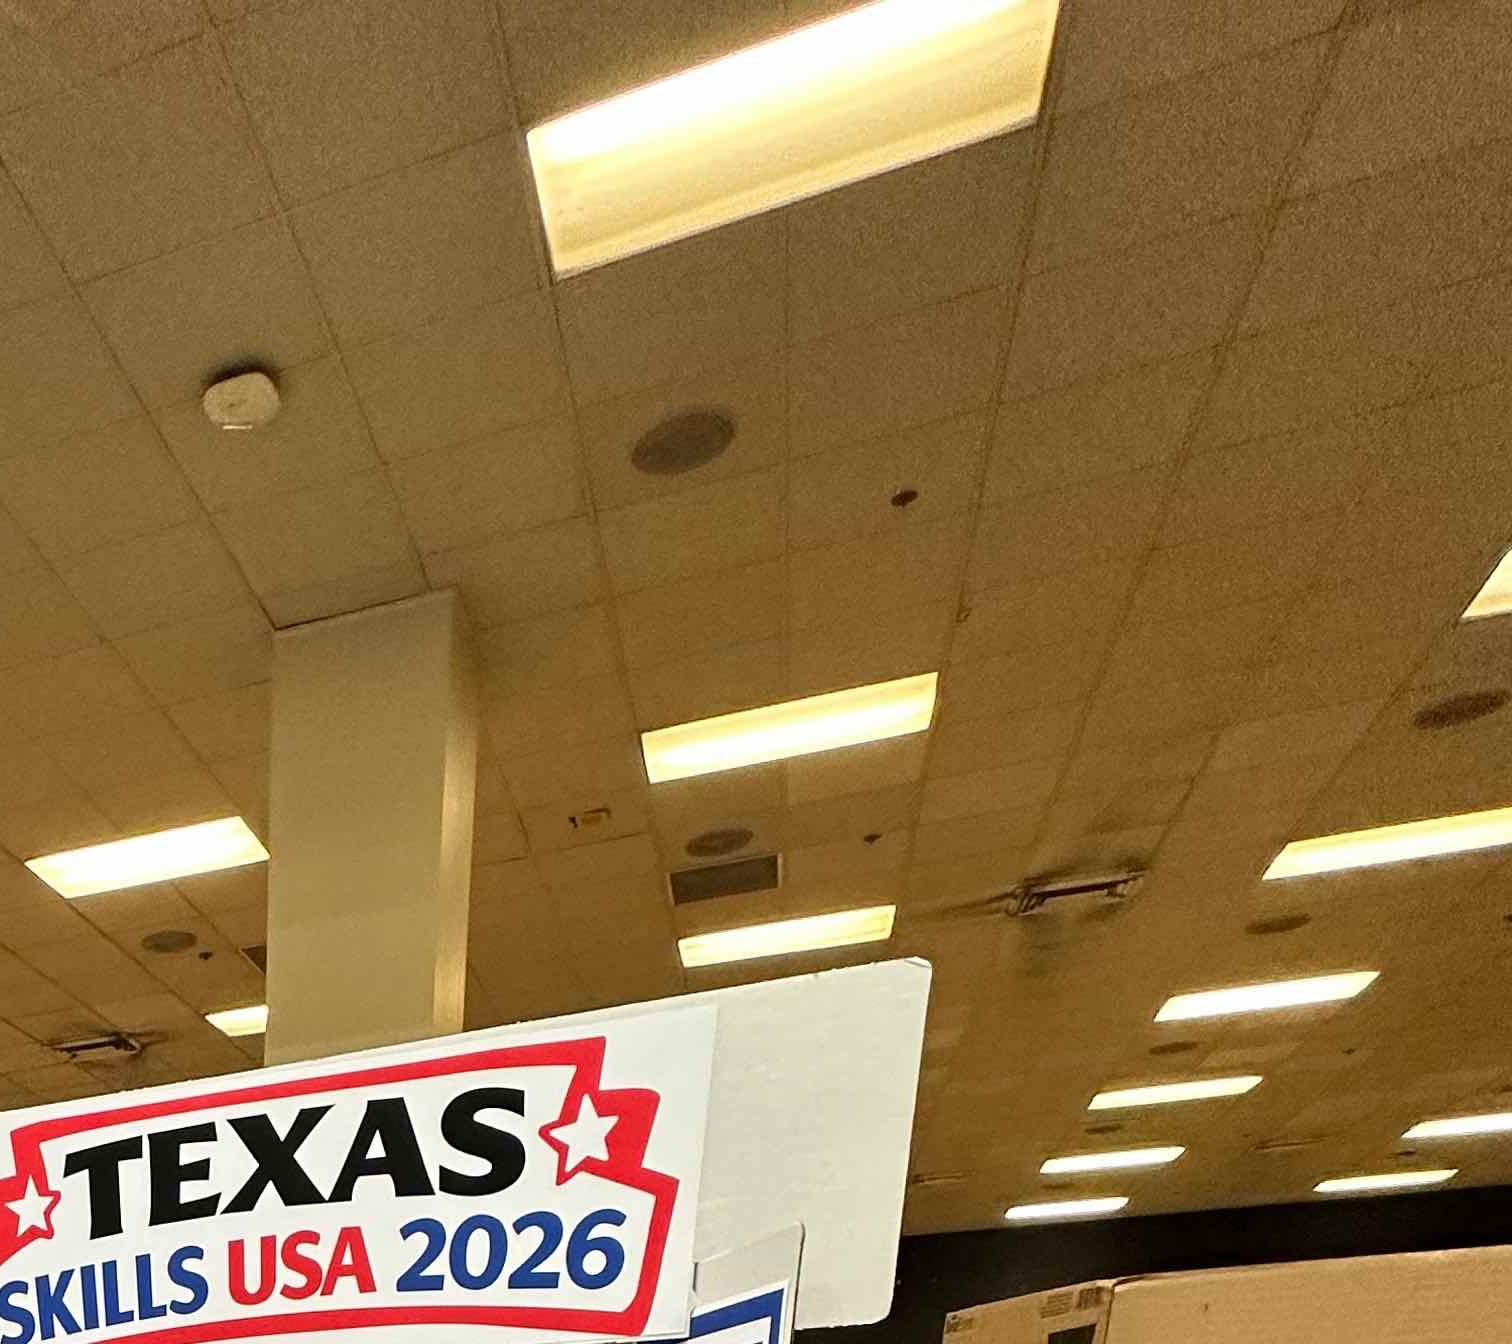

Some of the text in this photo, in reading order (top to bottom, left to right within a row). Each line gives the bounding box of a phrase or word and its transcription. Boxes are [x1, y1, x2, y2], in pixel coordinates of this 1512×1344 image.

[61, 1085, 525, 1240] TEXAS
[227, 1224, 377, 1306] USA
[396, 1208, 626, 1293] 2026
